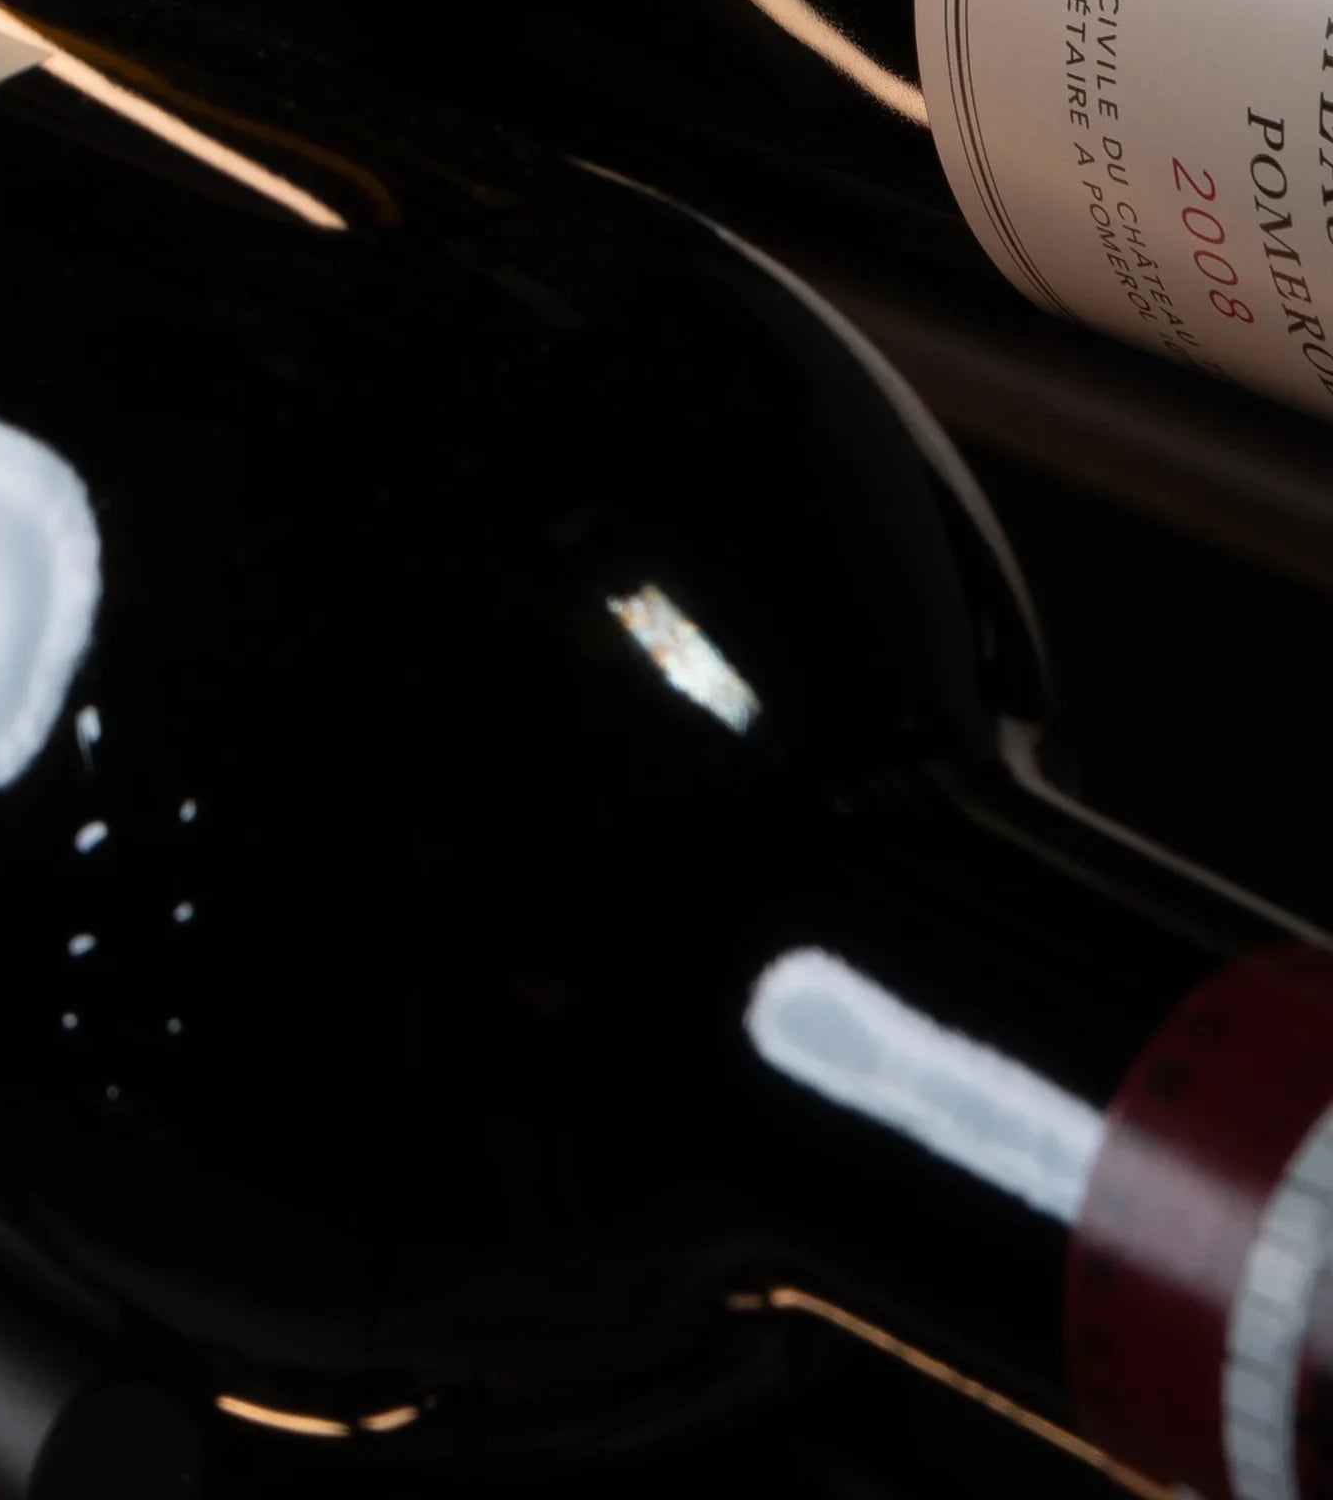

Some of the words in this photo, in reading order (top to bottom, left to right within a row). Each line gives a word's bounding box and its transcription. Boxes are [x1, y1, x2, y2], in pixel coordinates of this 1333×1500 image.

[1073, 140, 1096, 167] A
[1081, 179, 1153, 322] POMEROL
[1101, 135, 1129, 187] DU
[1116, 201, 1201, 348] CHÂTEAU
[1171, 156, 1256, 326] 2008
